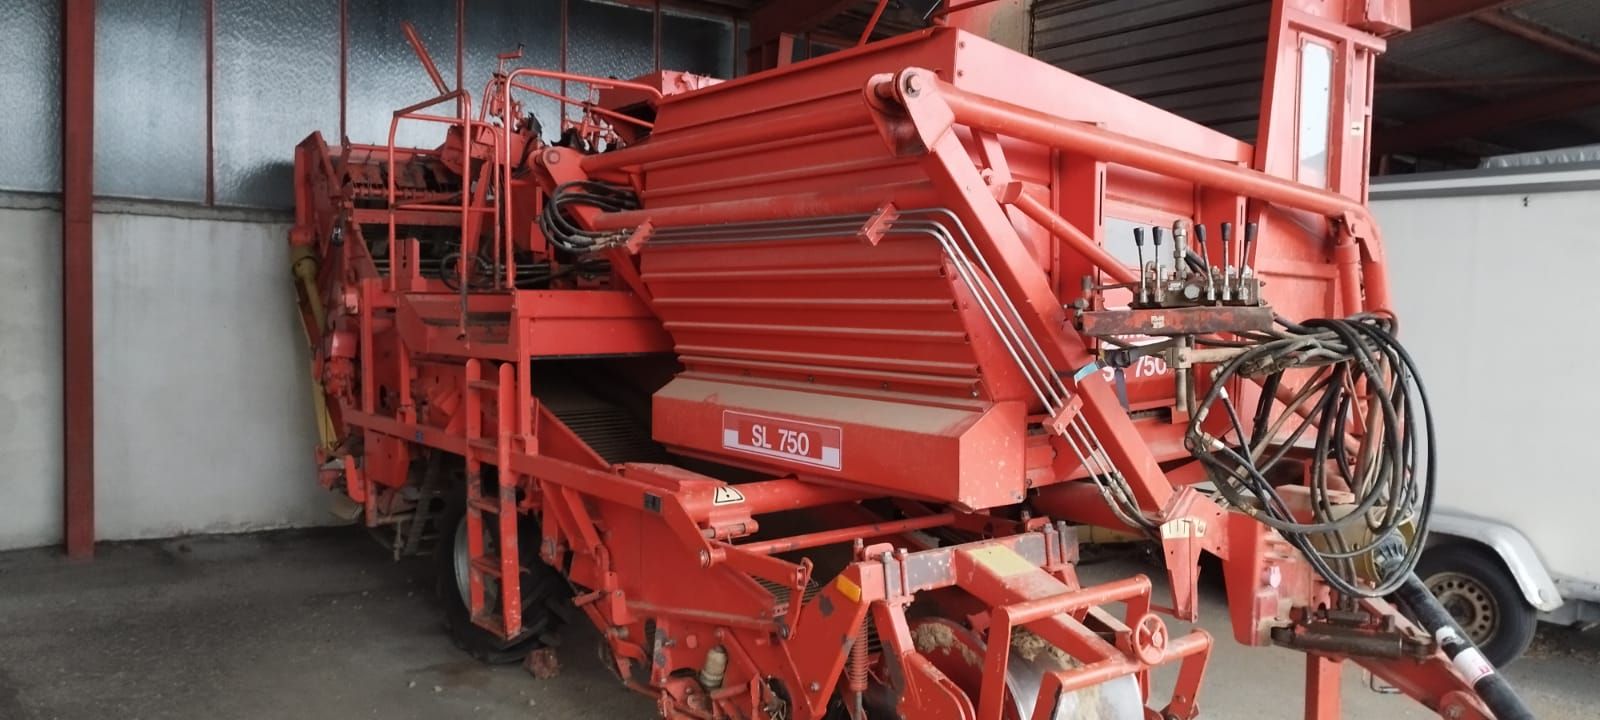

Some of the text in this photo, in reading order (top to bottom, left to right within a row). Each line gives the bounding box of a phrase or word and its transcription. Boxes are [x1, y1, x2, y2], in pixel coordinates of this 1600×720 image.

[1102, 365, 1127, 382] S
[751, 424, 809, 456] SL 750
